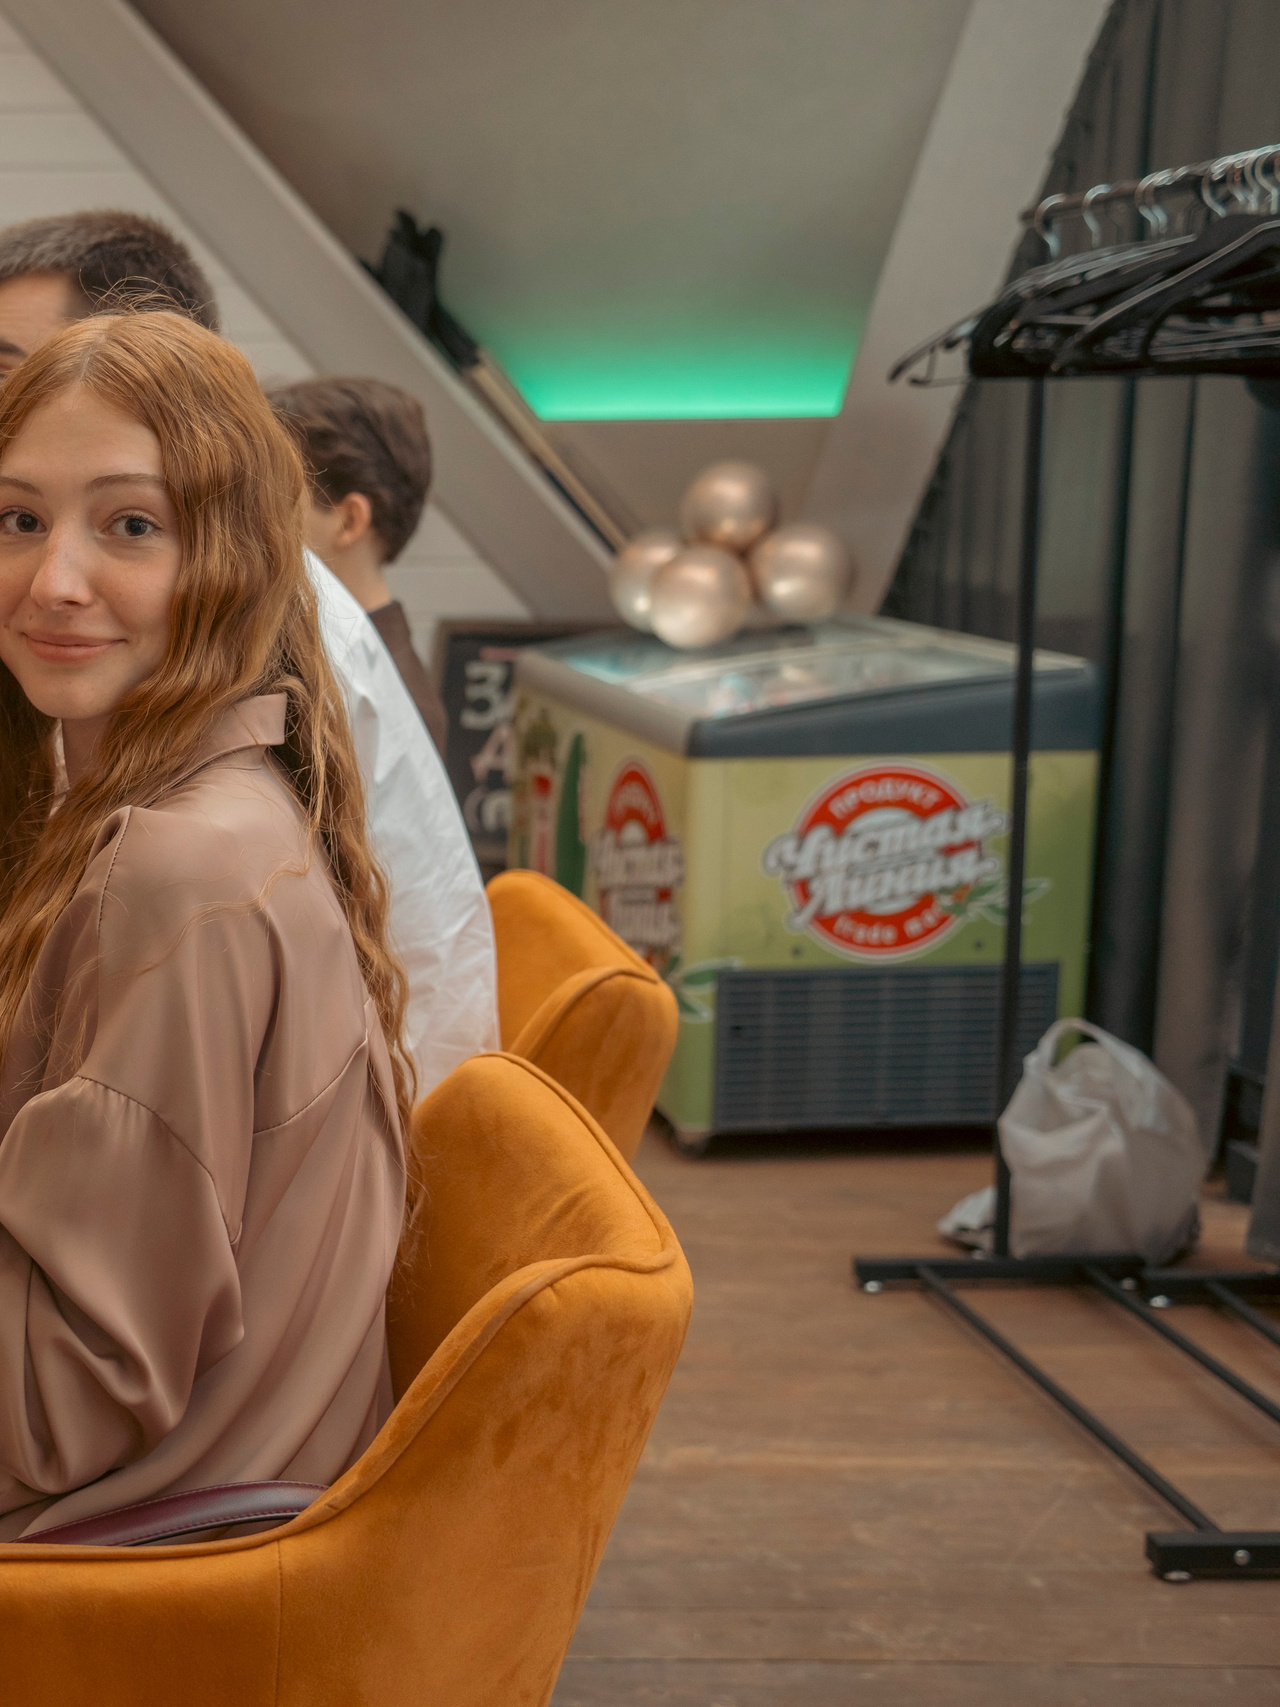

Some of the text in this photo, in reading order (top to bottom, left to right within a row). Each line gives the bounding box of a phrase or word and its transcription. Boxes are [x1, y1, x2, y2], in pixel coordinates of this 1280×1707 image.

[828, 777, 941, 820] ПРОДУКТ
[766, 802, 1004, 880] Чистая
[788, 850, 998, 927] Линия
